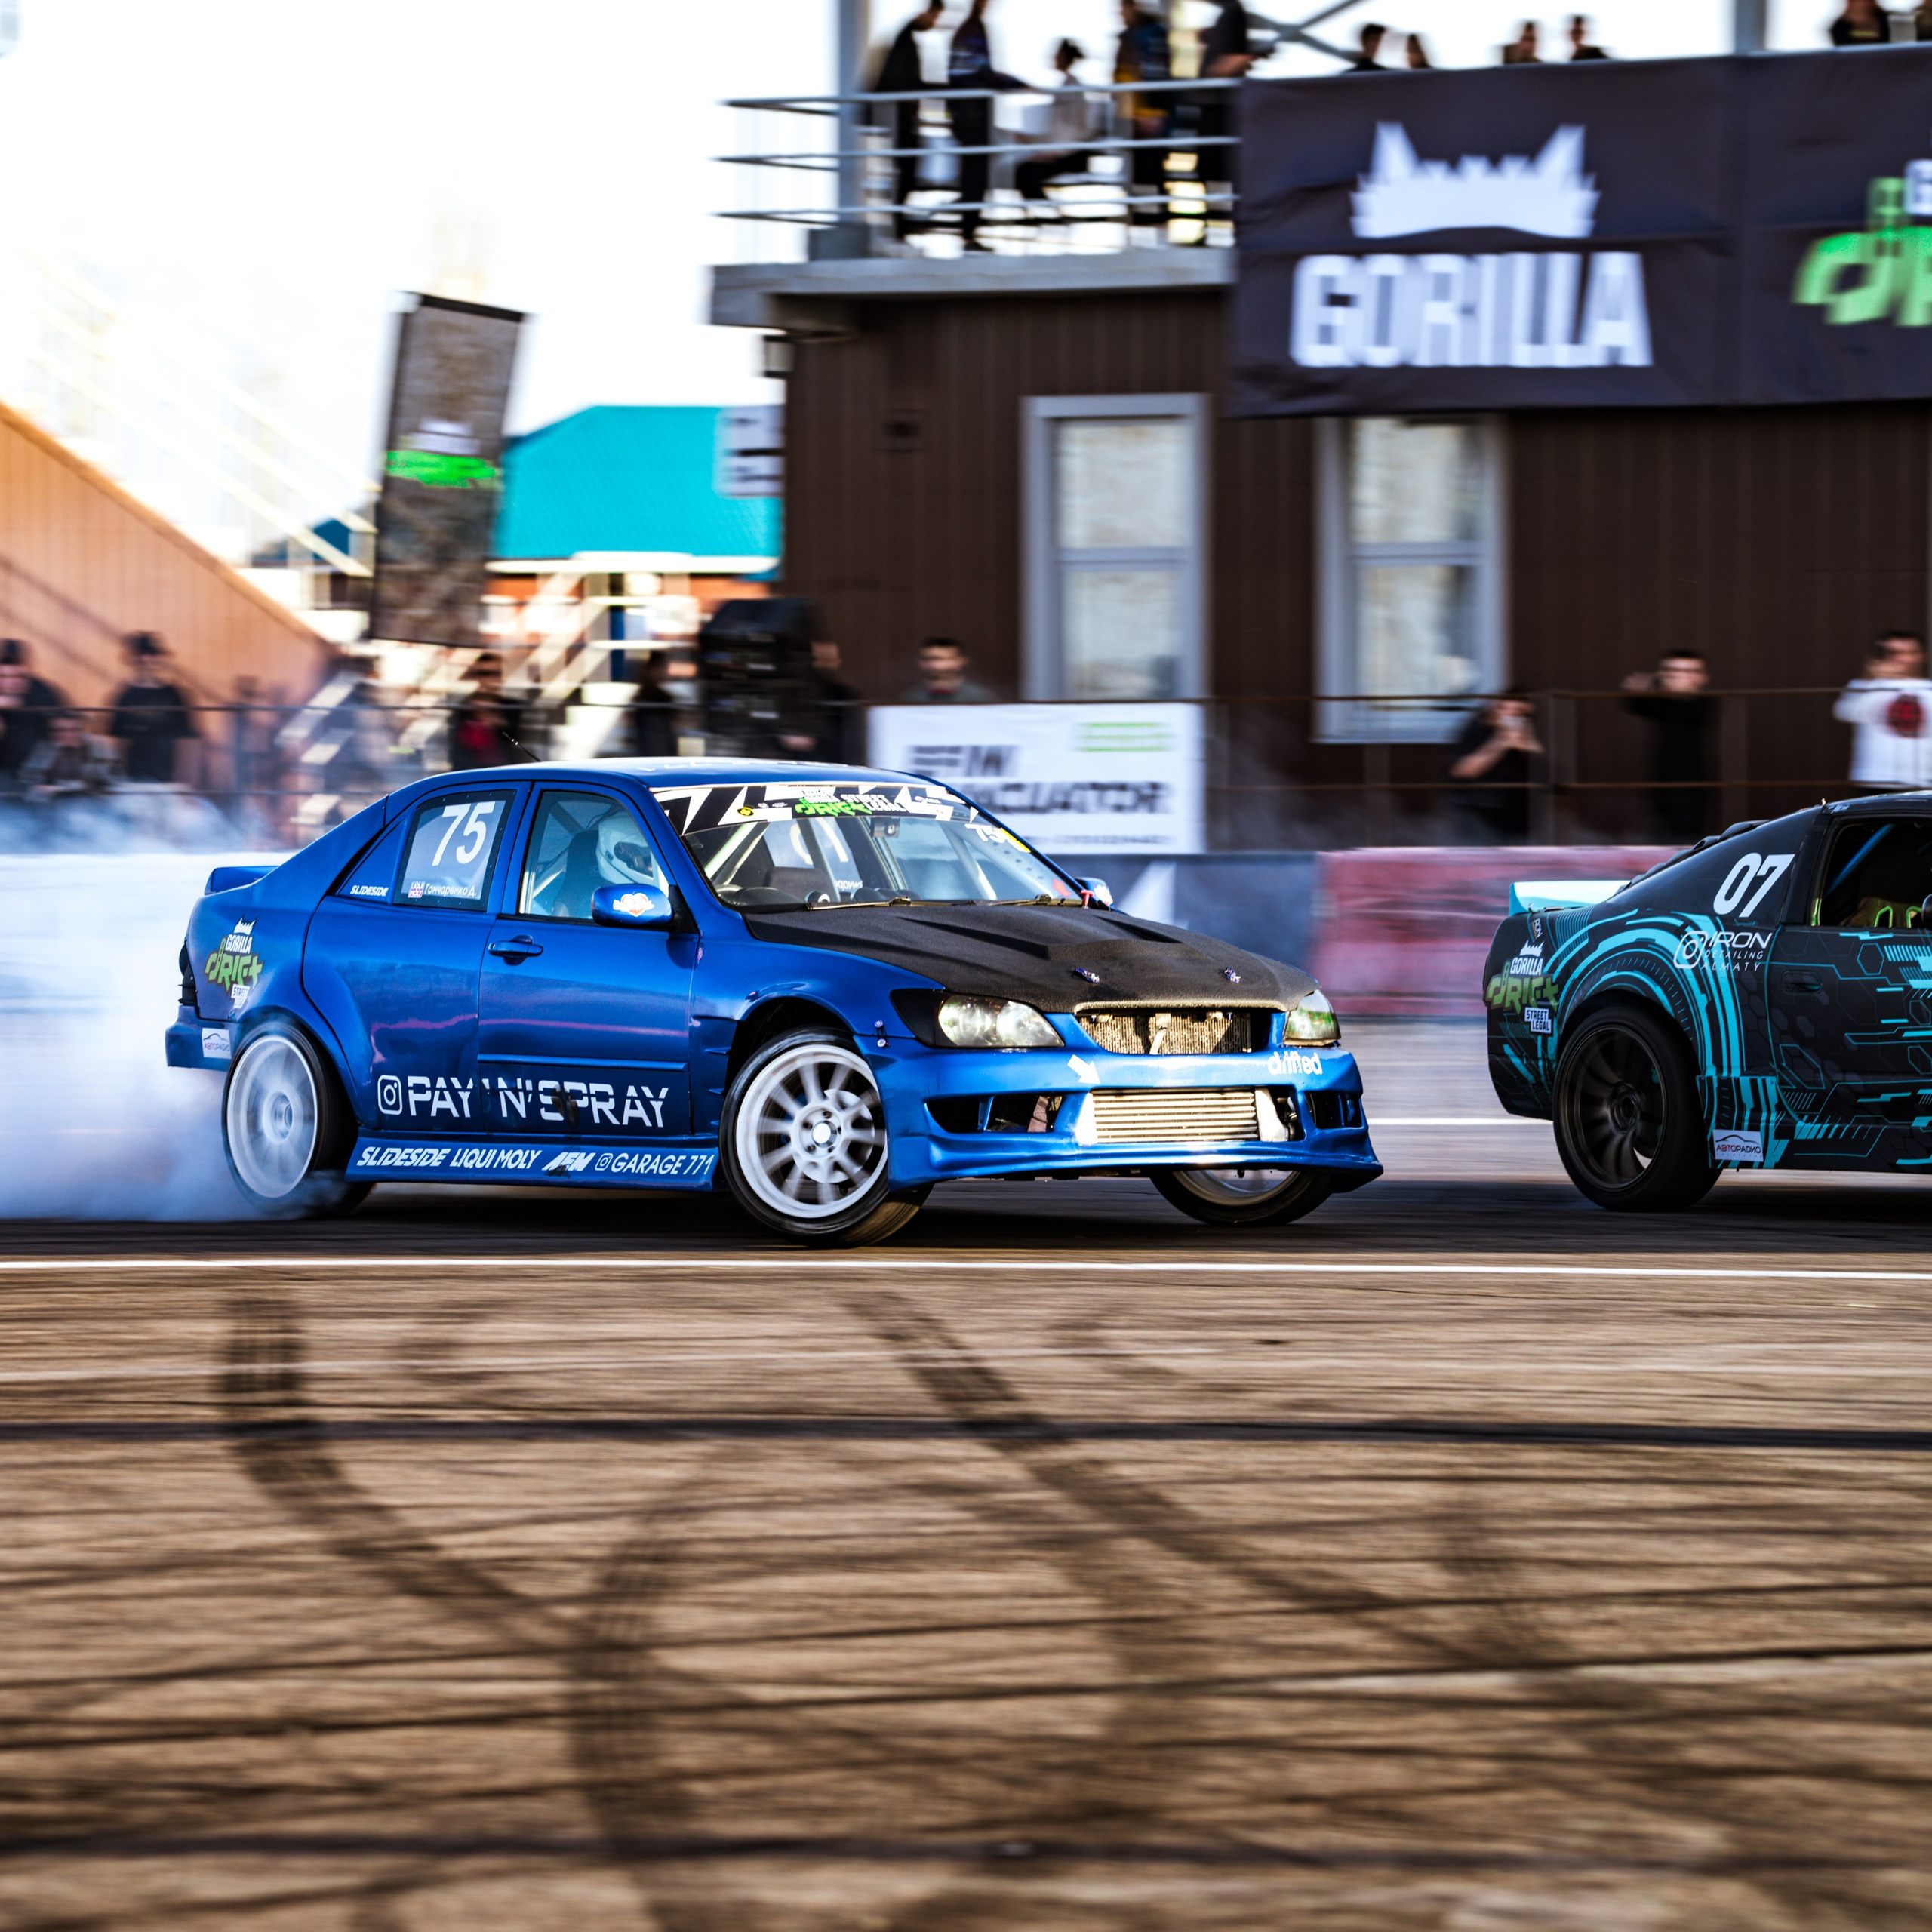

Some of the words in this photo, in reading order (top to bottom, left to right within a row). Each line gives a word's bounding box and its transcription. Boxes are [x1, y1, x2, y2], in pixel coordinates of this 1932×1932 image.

[1290, 251, 1654, 368] GORILLA
[432, 801, 495, 866] 75
[349, 884, 389, 897] SLIDESIDE
[424, 883, 469, 897] Гончаренко
[1713, 852, 1795, 918] 07
[225, 934, 253, 954] GORILLA
[1709, 931, 1773, 949] IRON
[1704, 949, 1764, 960] DETAILING
[1510, 957, 1544, 975] GORILLA
[1700, 961, 1761, 972] ALMATY
[1526, 1010, 1548, 1020] STREET
[1532, 1020, 1551, 1032] LEGAL
[1268, 1051, 1323, 1075] drifted
[408, 1076, 473, 1118] PAY
[538, 1080, 669, 1128] SPRAY
[357, 1146, 451, 1167] SLIDESIDE
[450, 1148, 497, 1168] LIQUI
[493, 1149, 542, 1169] MOLY
[611, 1152, 687, 1174] GARAGE
[683, 1155, 715, 1175] 771
